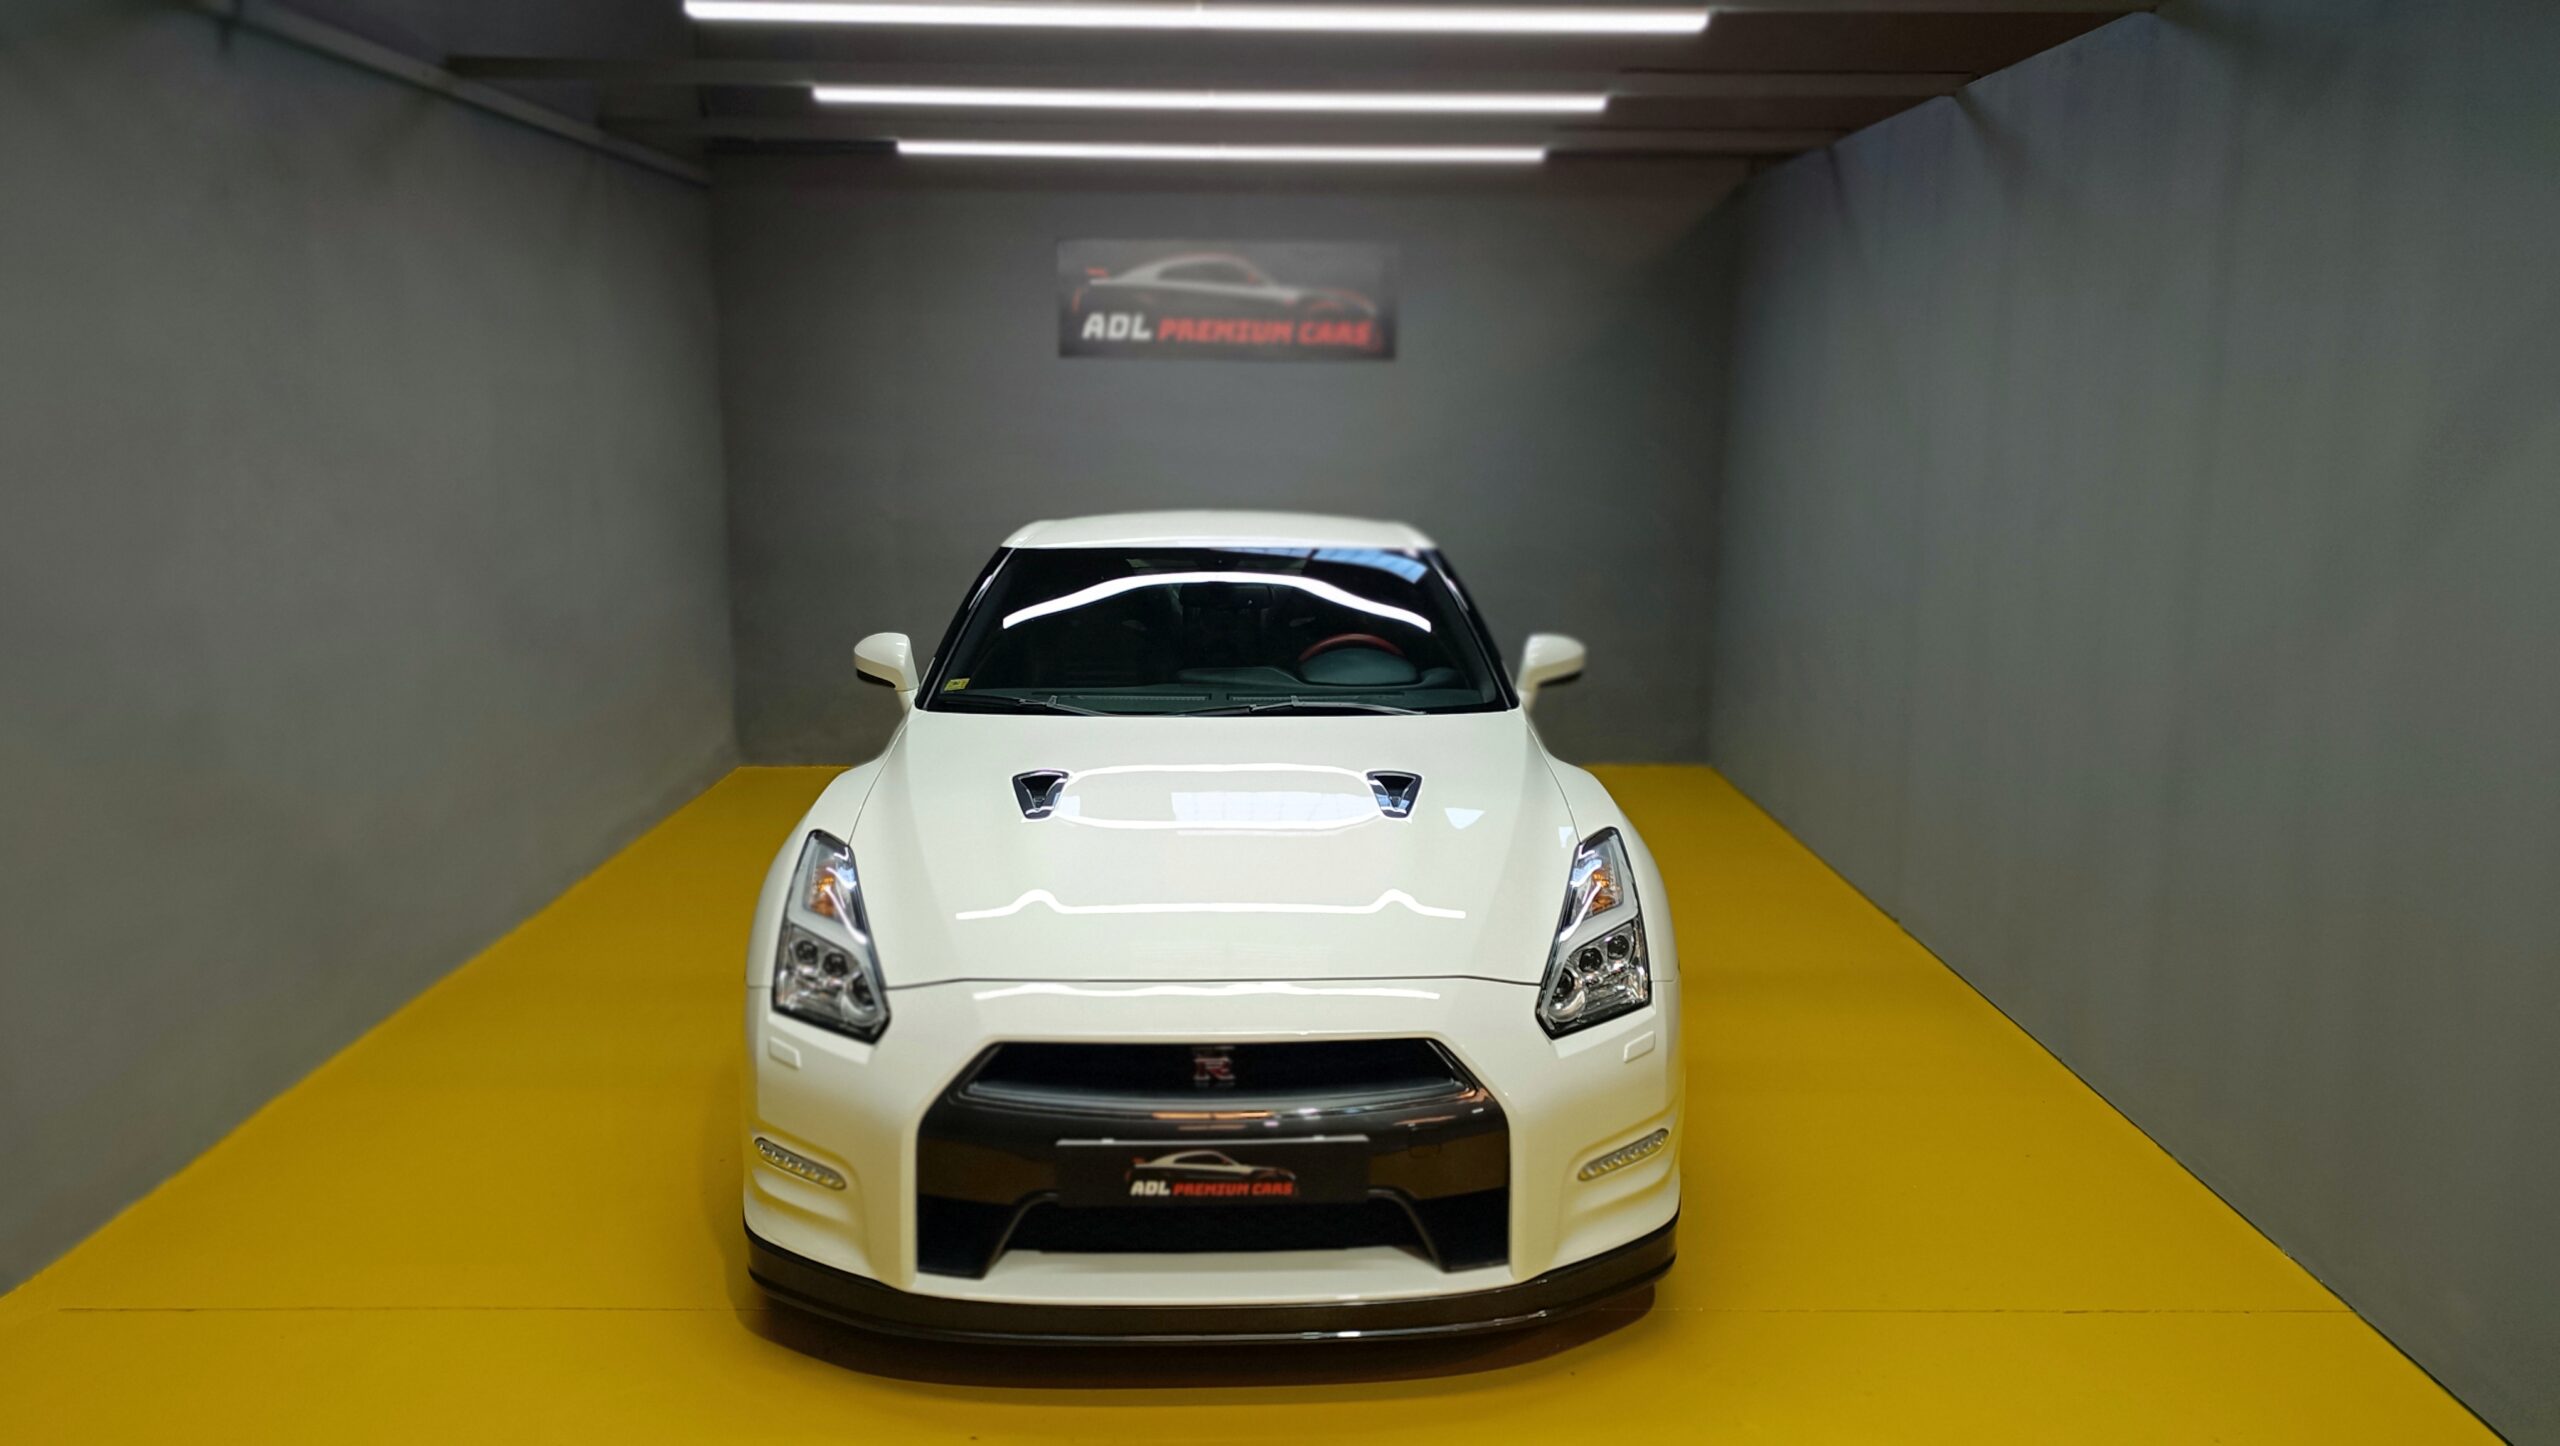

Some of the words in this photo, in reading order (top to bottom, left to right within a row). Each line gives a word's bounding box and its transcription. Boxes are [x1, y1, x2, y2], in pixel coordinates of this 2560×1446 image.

[1082, 312, 1152, 340] ADL
[1158, 317, 1293, 343] PREMIUM
[1299, 319, 1372, 346] CARS
[1130, 1180, 1171, 1196] ADL
[1173, 1182, 1249, 1196] PREMIUM
[1252, 1182, 1294, 1196] CARS
